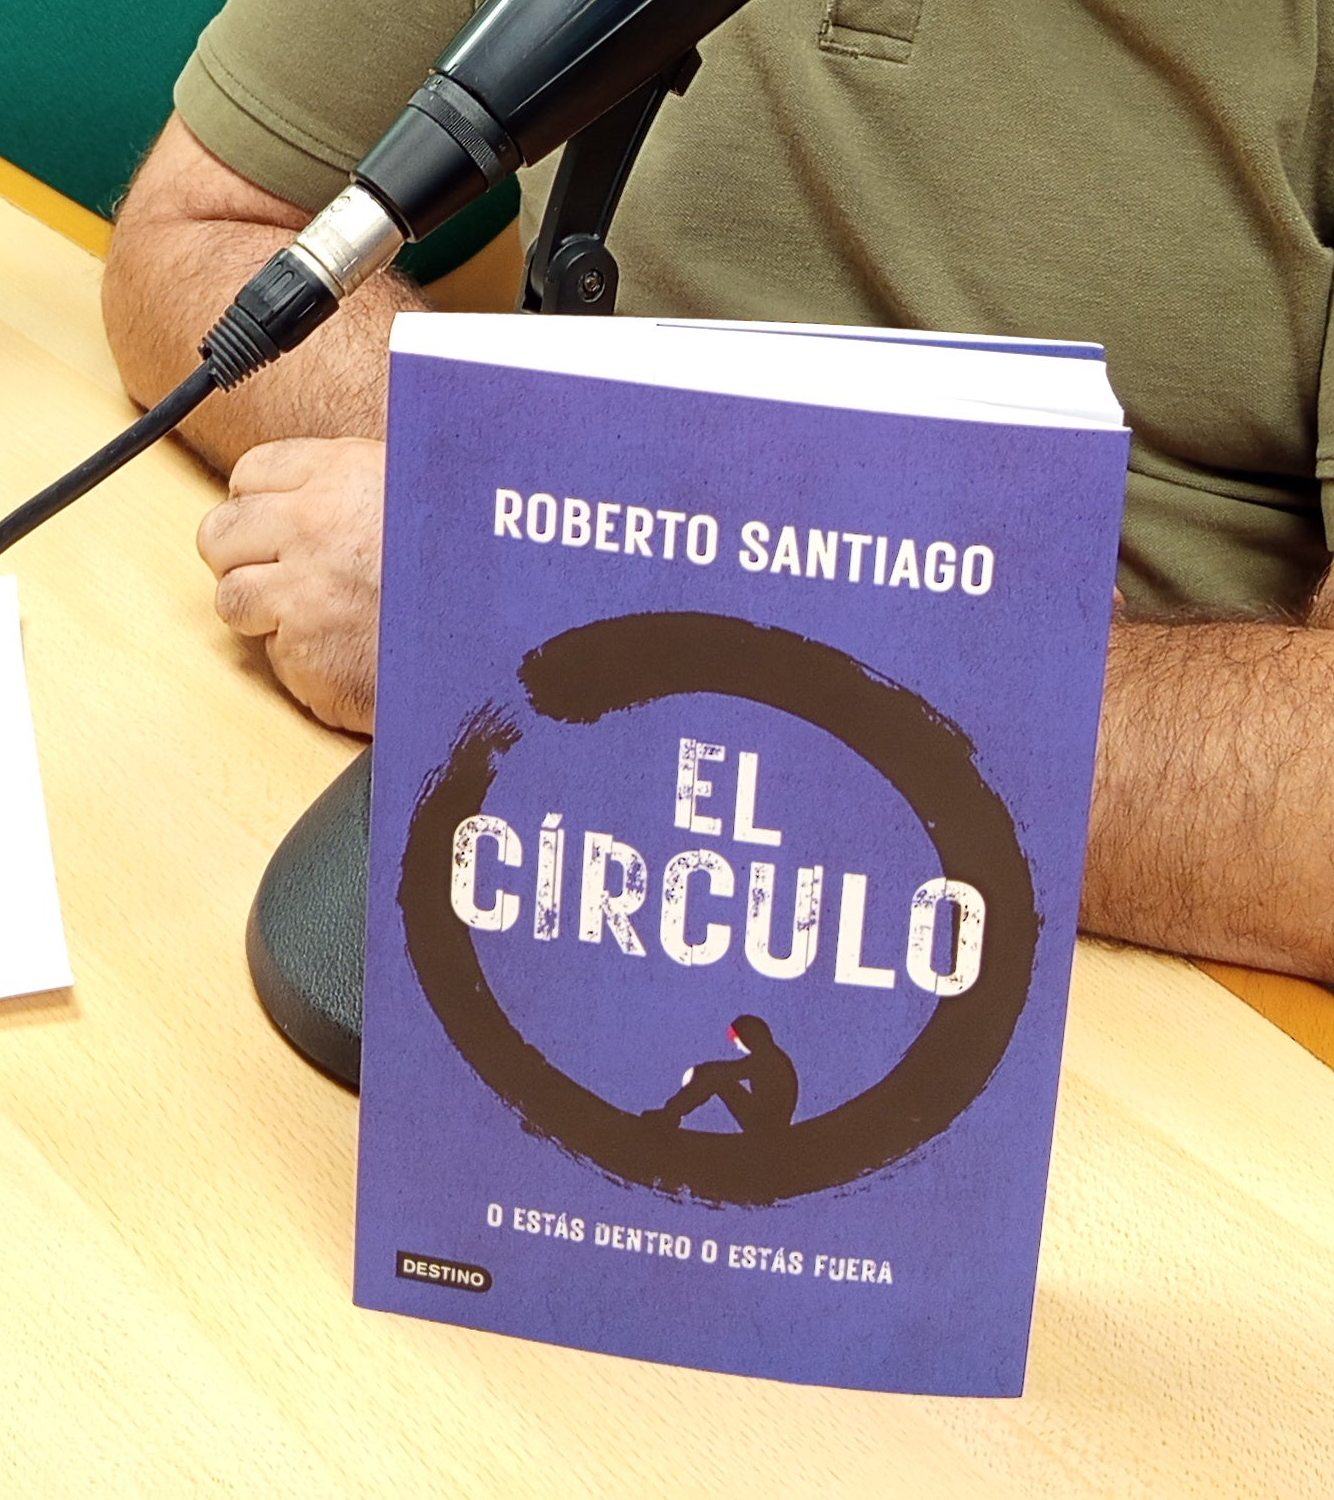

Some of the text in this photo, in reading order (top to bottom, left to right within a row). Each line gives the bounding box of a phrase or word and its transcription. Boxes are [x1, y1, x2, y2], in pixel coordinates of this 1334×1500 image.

[493, 487, 995, 596] ROBERTO SANTIAGO
[673, 737, 782, 847] EL
[450, 811, 986, 998] CÍRCULO
[403, 1257, 485, 1287] DESTINO
[486, 1203, 893, 1285] O ESTÁS DENTRO O ESTÁS FUERA
